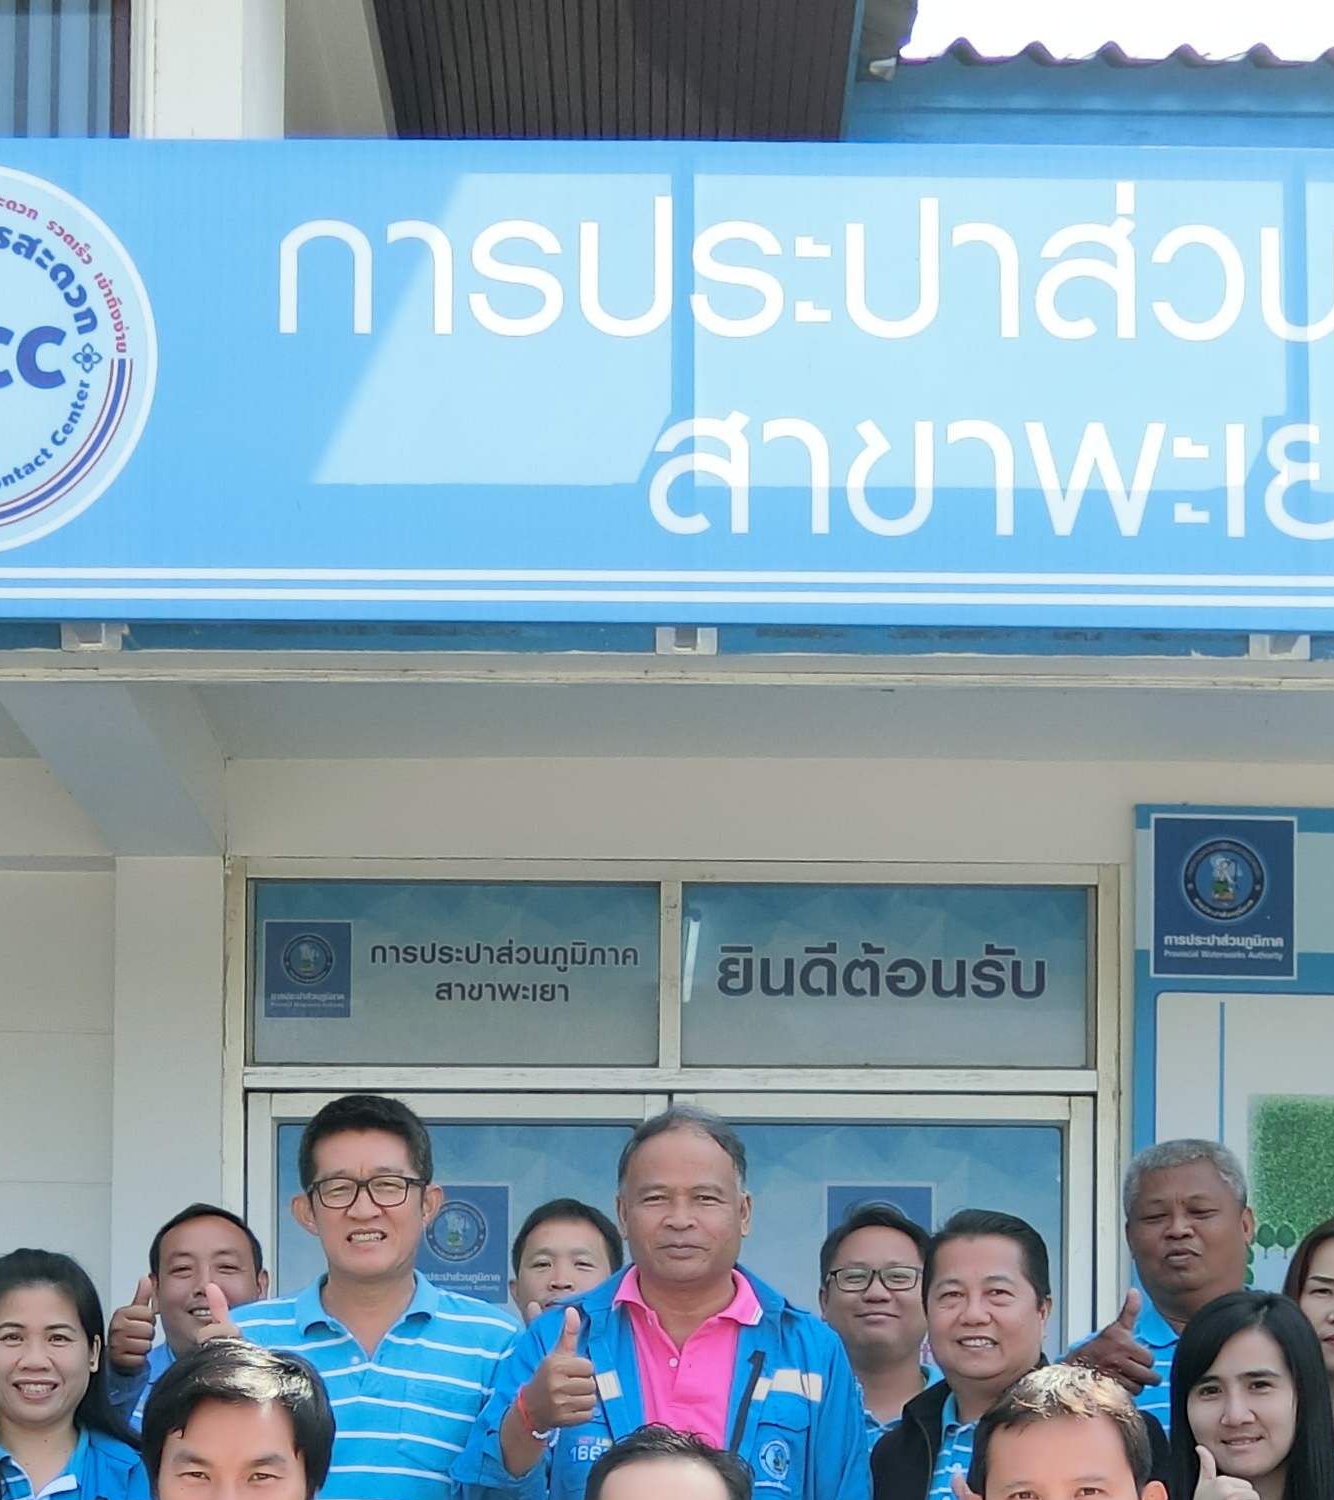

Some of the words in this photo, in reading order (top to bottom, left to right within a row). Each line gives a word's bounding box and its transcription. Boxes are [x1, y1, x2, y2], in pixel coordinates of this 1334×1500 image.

[46, 219, 94, 266] รวดเร็ว
[94, 272, 130, 354] เข้าถึงง่าย
[50, 379, 91, 447] Center
[370, 940, 639, 972] การประปาส่วนภูมิภาค
[716, 941, 1047, 1000] ยินดีต้อนรับ
[434, 977, 570, 1004] สาขาพะเยา
[570, 1446, 609, 1463] 166
